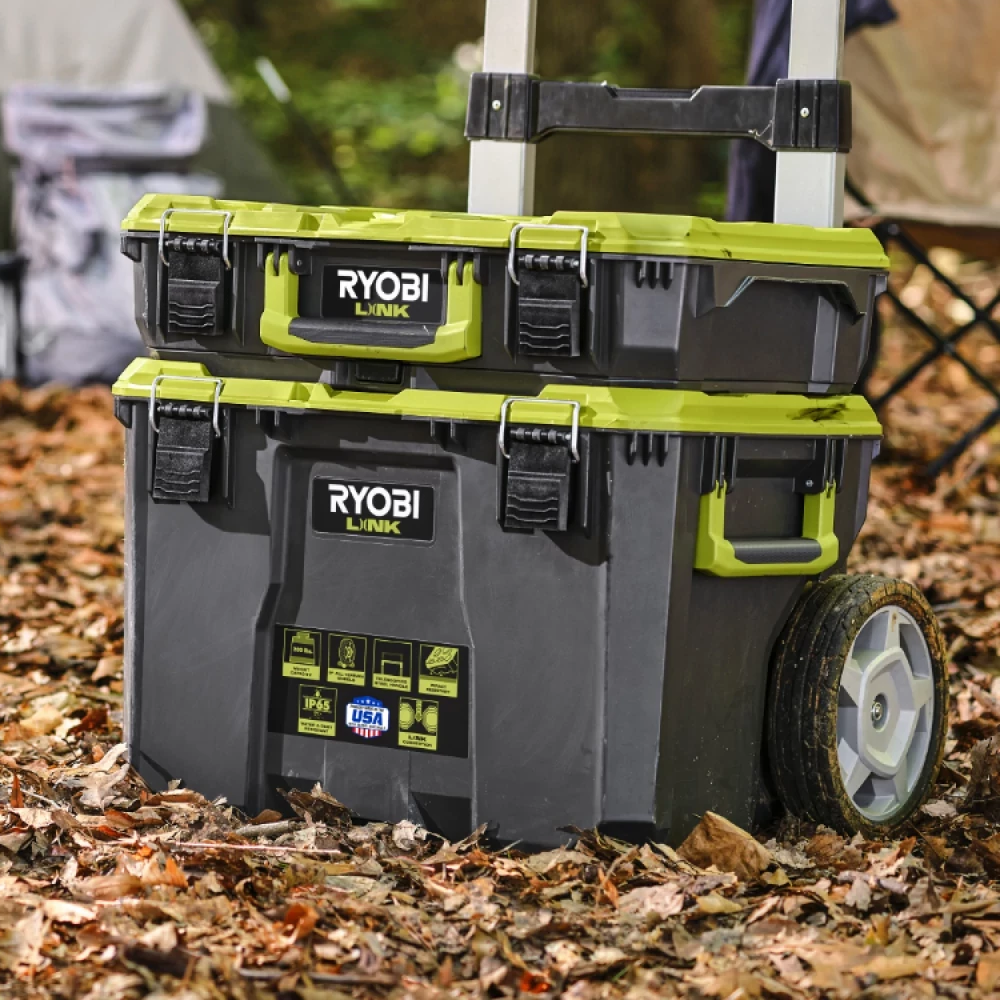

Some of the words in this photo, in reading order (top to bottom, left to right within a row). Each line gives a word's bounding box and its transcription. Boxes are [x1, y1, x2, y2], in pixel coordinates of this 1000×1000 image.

[337, 269, 429, 302] RYOBI
[355, 302, 410, 318] LINK
[328, 483, 420, 519] RYOBI
[346, 517, 401, 535] LINK
[304, 697, 330, 711] IP65
[352, 708, 383, 726] USA
